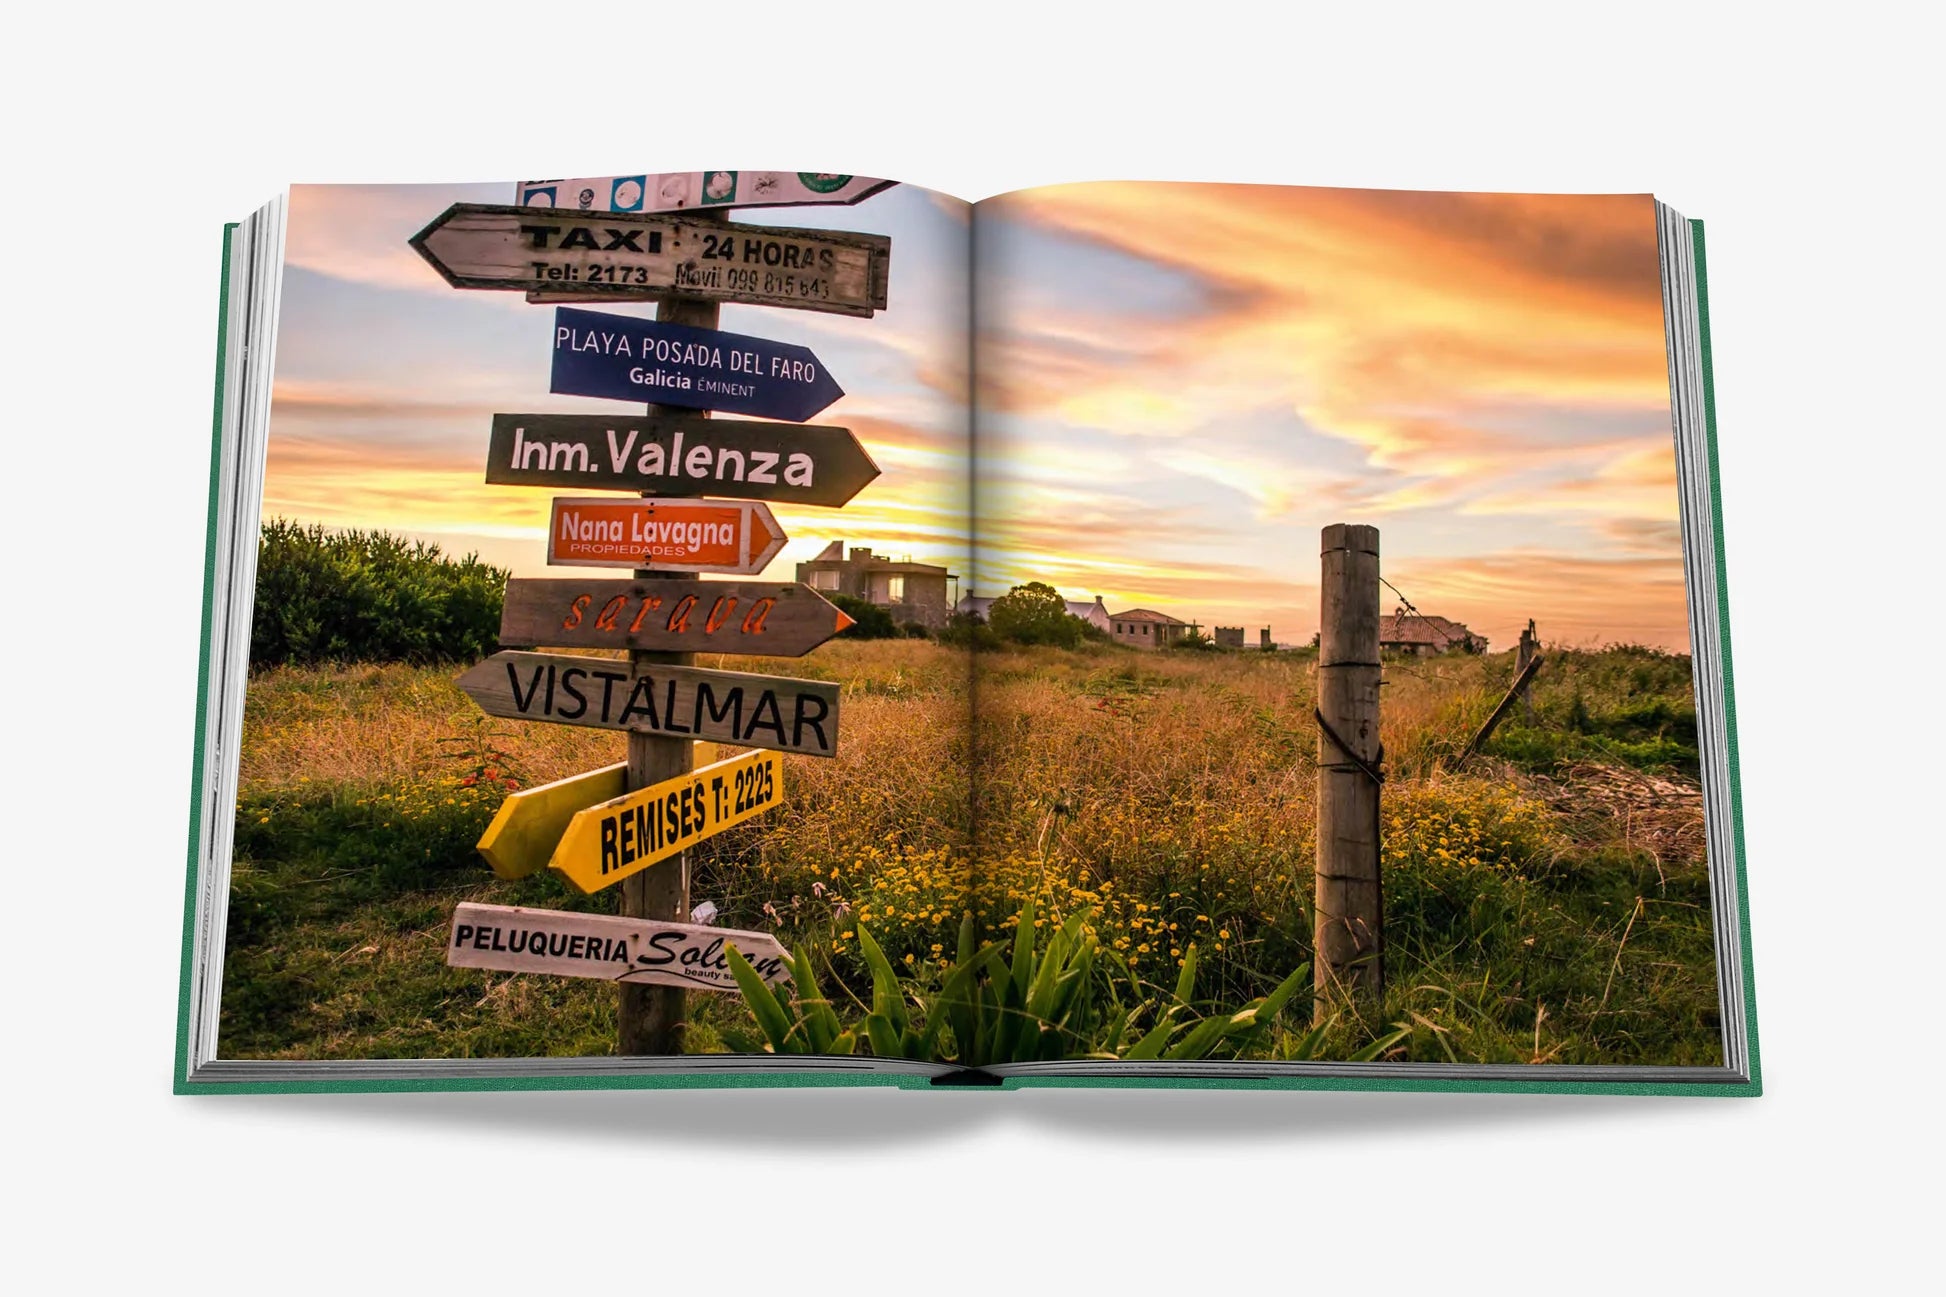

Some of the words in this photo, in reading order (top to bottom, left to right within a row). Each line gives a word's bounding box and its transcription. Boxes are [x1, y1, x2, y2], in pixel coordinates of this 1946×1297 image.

[520, 224, 663, 255] TAXI
[702, 234, 735, 262] 24
[743, 239, 834, 271] HORAS
[531, 261, 579, 282] Tel:
[587, 264, 649, 285] 2173
[728, 268, 759, 293] 099
[764, 272, 794, 296] 815
[556, 327, 632, 357] PLAYA
[642, 338, 722, 369] POSADA
[730, 350, 764, 376] DEL
[771, 357, 816, 384] FARO
[629, 366, 691, 390] Galicia
[510, 427, 599, 473] Inm.
[606, 430, 815, 488] Valenza
[561, 511, 624, 542] Nana
[632, 512, 734, 552] Lavagna
[570, 543, 685, 557] PROPIEDADES
[563, 593, 777, 635] sarava
[506, 662, 829, 750] VISTALMAR
[601, 783, 706, 875] REMISES
[712, 776, 729, 824] T:
[734, 760, 774, 814] 2225
[455, 924, 629, 963] PELUQUERIA
[684, 967, 720, 981] beauty
